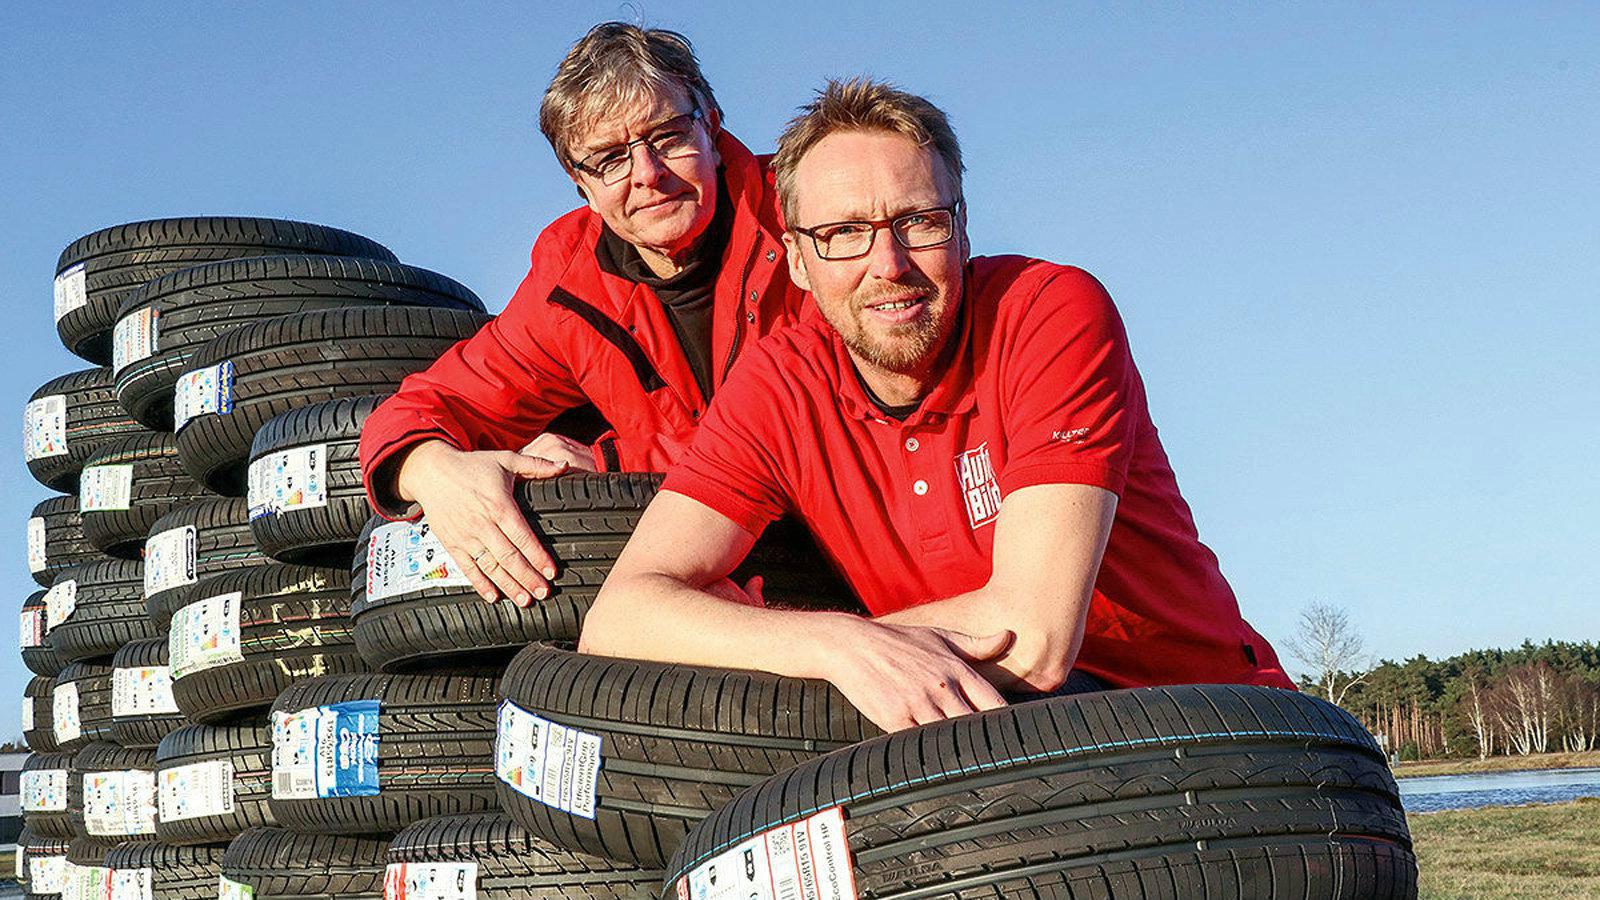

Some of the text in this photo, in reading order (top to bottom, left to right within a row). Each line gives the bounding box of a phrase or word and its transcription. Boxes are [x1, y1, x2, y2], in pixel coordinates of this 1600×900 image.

[574, 741, 589, 808] EfficientGrip
[582, 741, 596, 813] Performance
[796, 831, 808, 851] 91V
[823, 841, 842, 900] EcoControl
